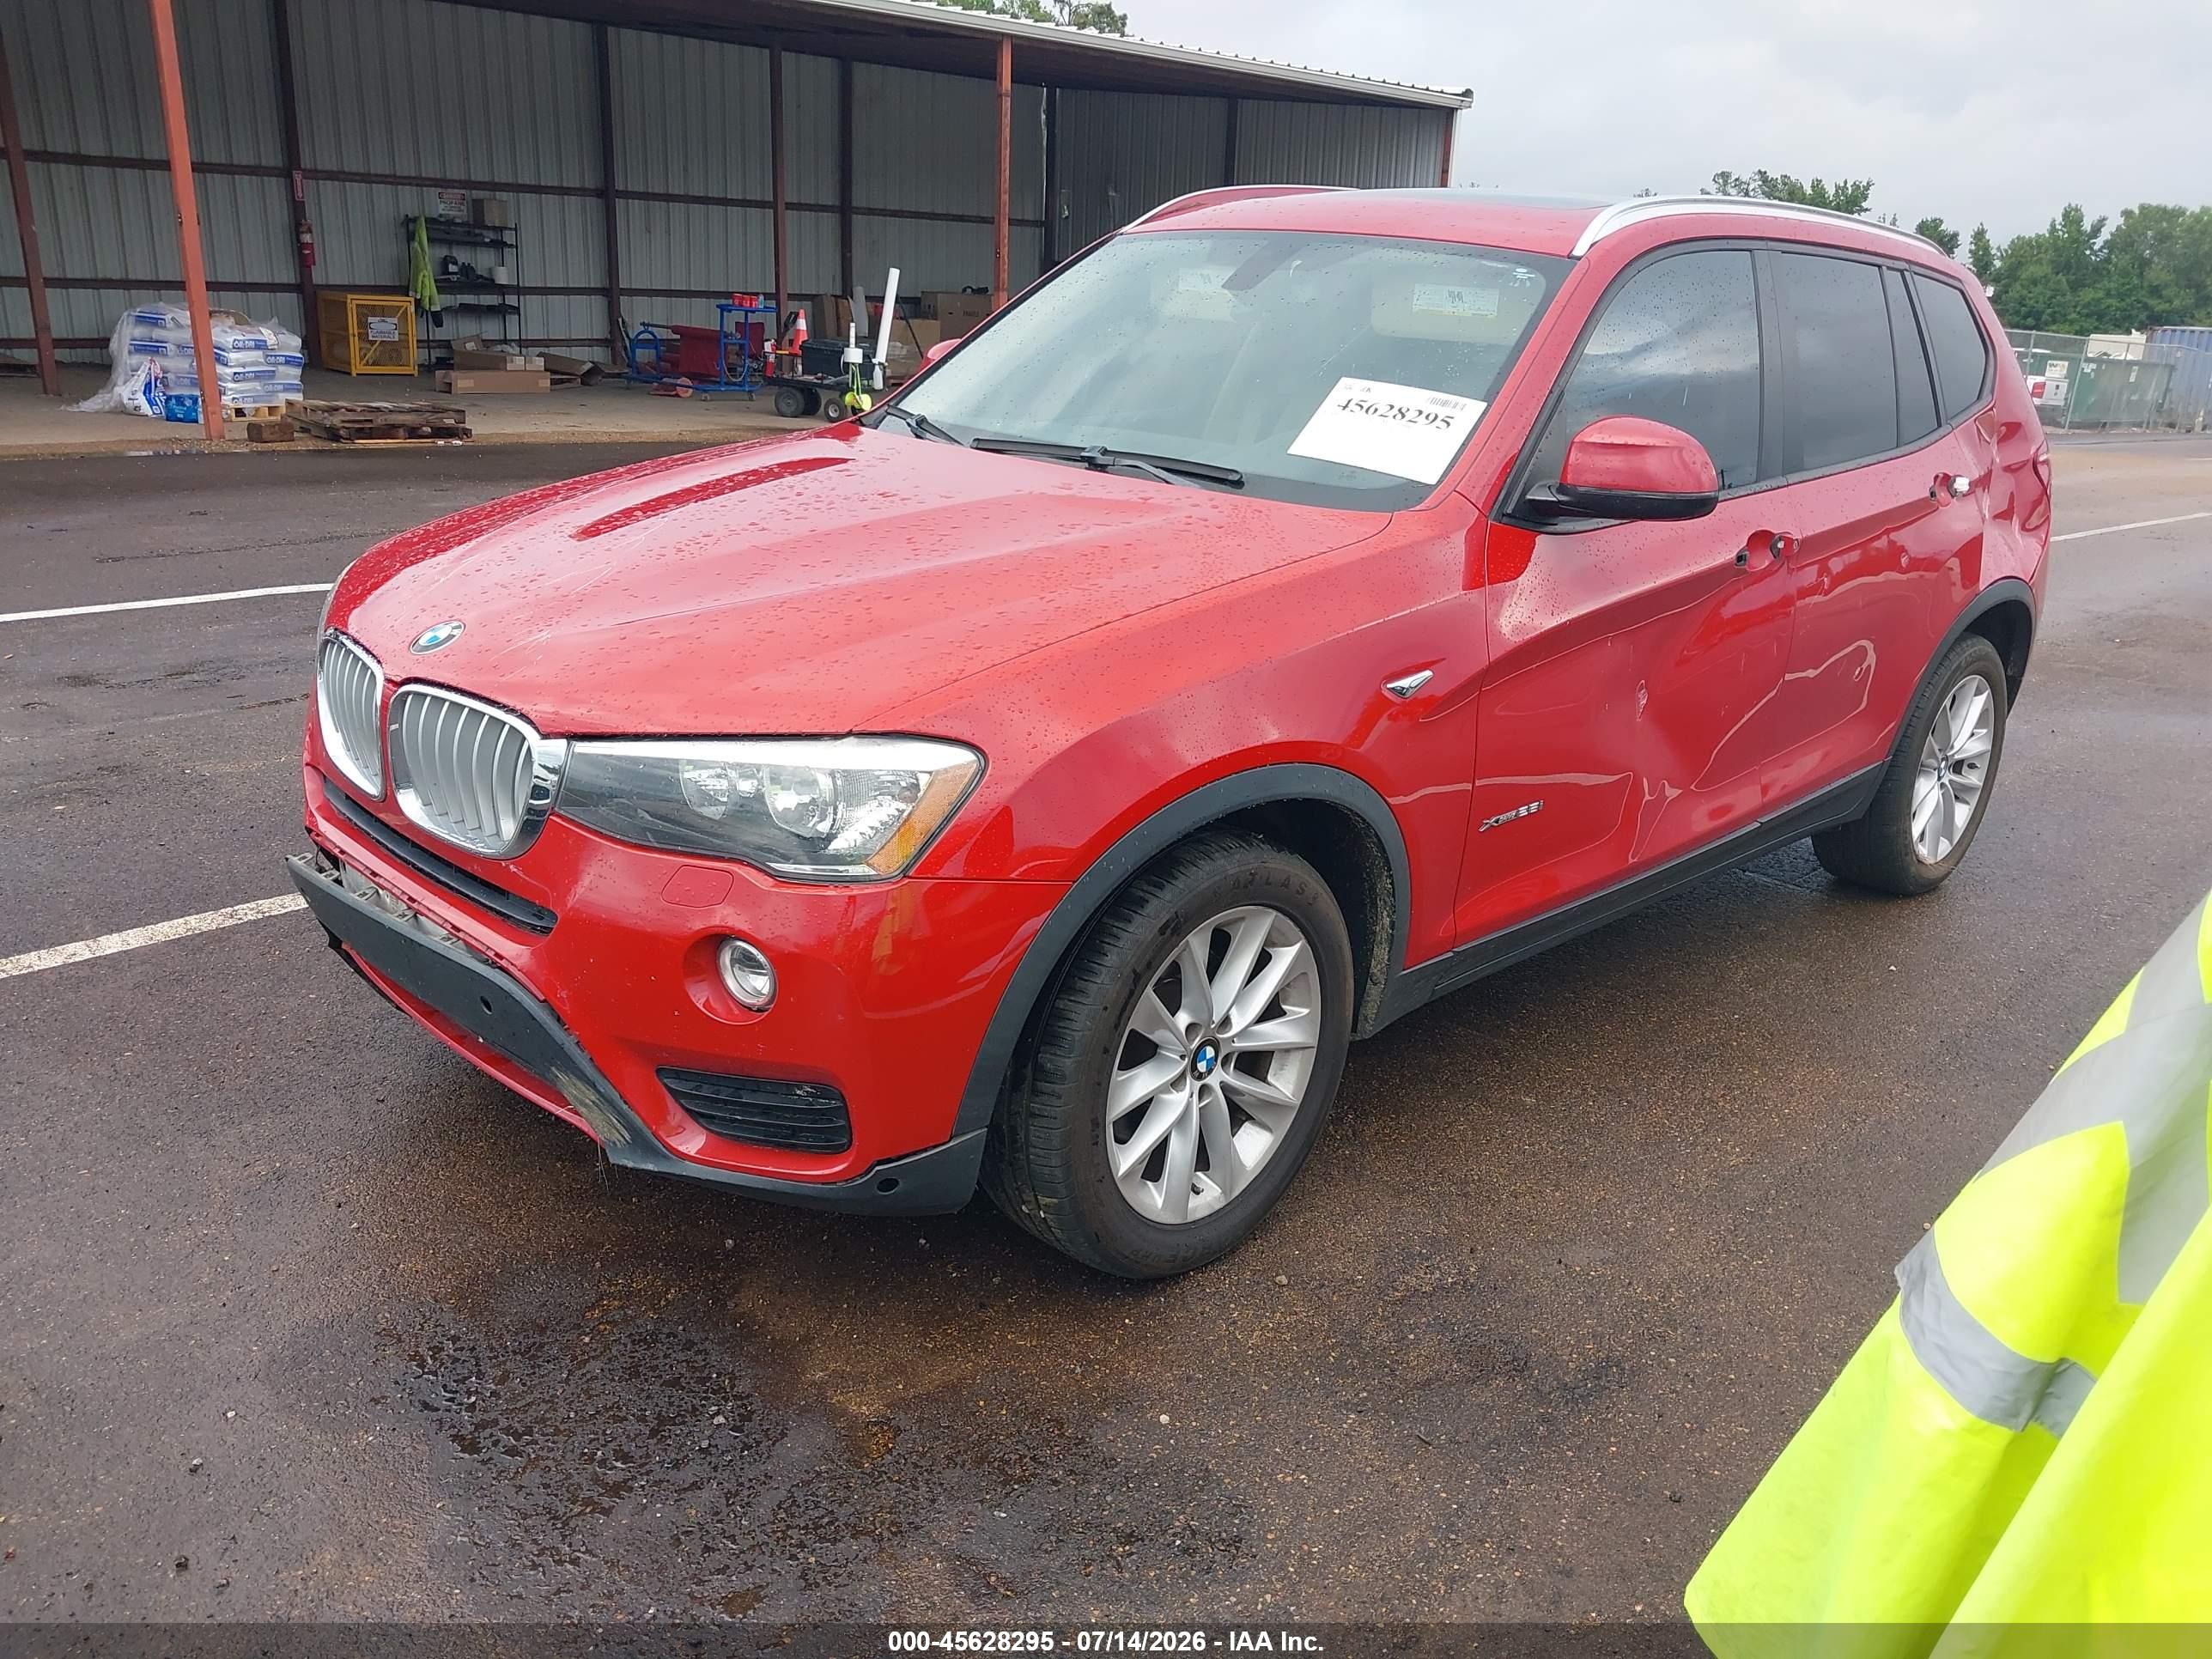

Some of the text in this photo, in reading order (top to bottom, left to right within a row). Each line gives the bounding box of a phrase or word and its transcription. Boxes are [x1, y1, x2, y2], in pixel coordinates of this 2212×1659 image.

[234, 340, 255, 349] OIL-DRI
[234, 373, 255, 381] OIL-DRI
[1337, 398, 1455, 430] 45628295
